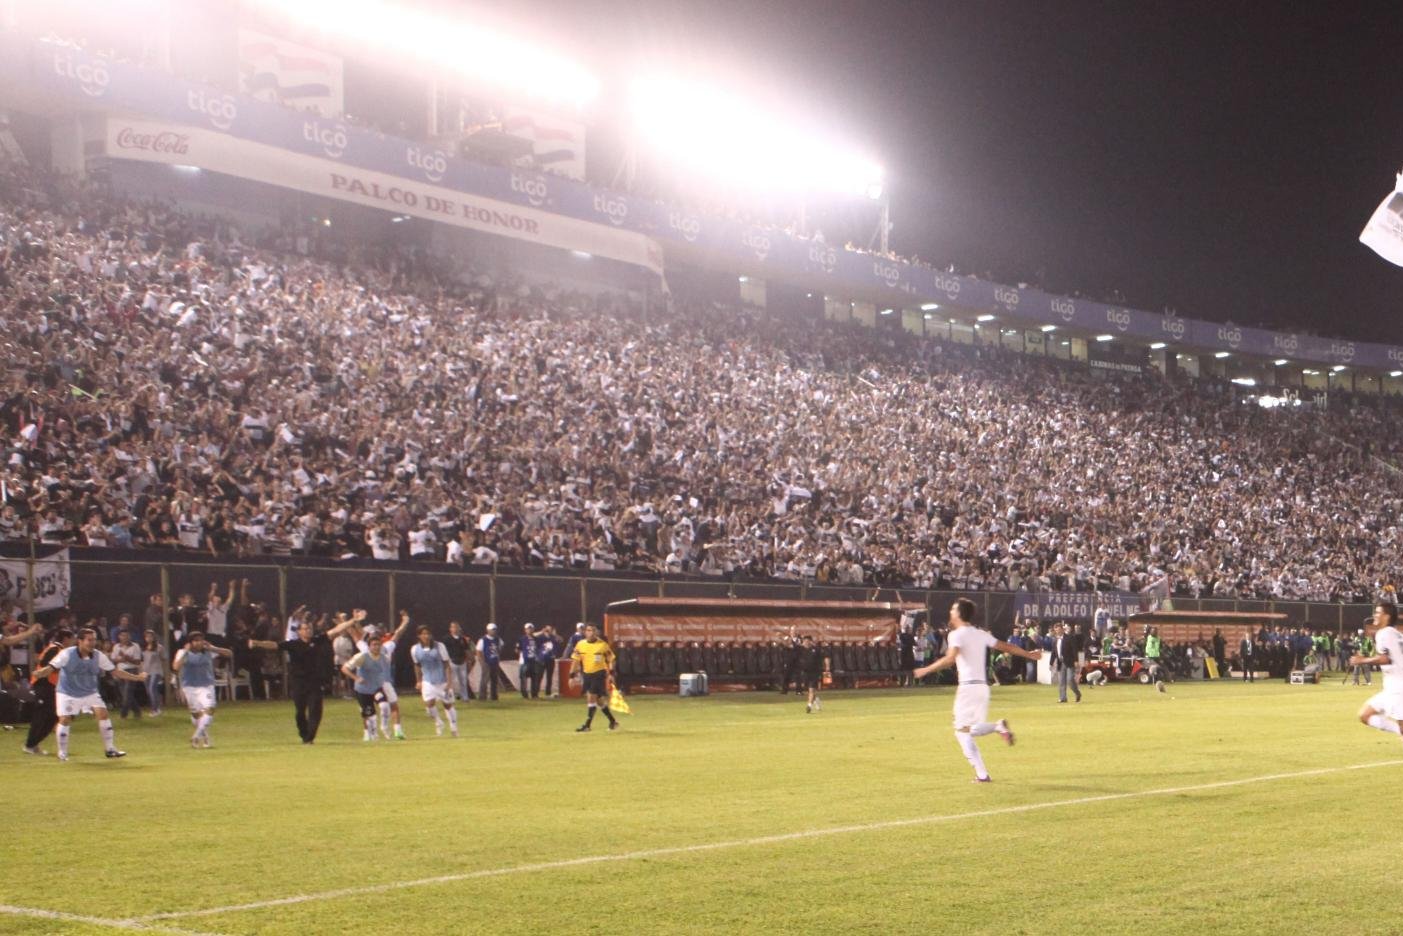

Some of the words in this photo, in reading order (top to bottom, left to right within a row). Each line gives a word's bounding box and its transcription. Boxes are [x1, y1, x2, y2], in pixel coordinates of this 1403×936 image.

[115, 127, 192, 155] Coca-Cola
[330, 172, 417, 207] PALCO
[423, 194, 456, 217] DE
[462, 203, 540, 234] HONOR
[1023, 604, 1039, 617] DR
[1044, 604, 1087, 617] ADOLFO
